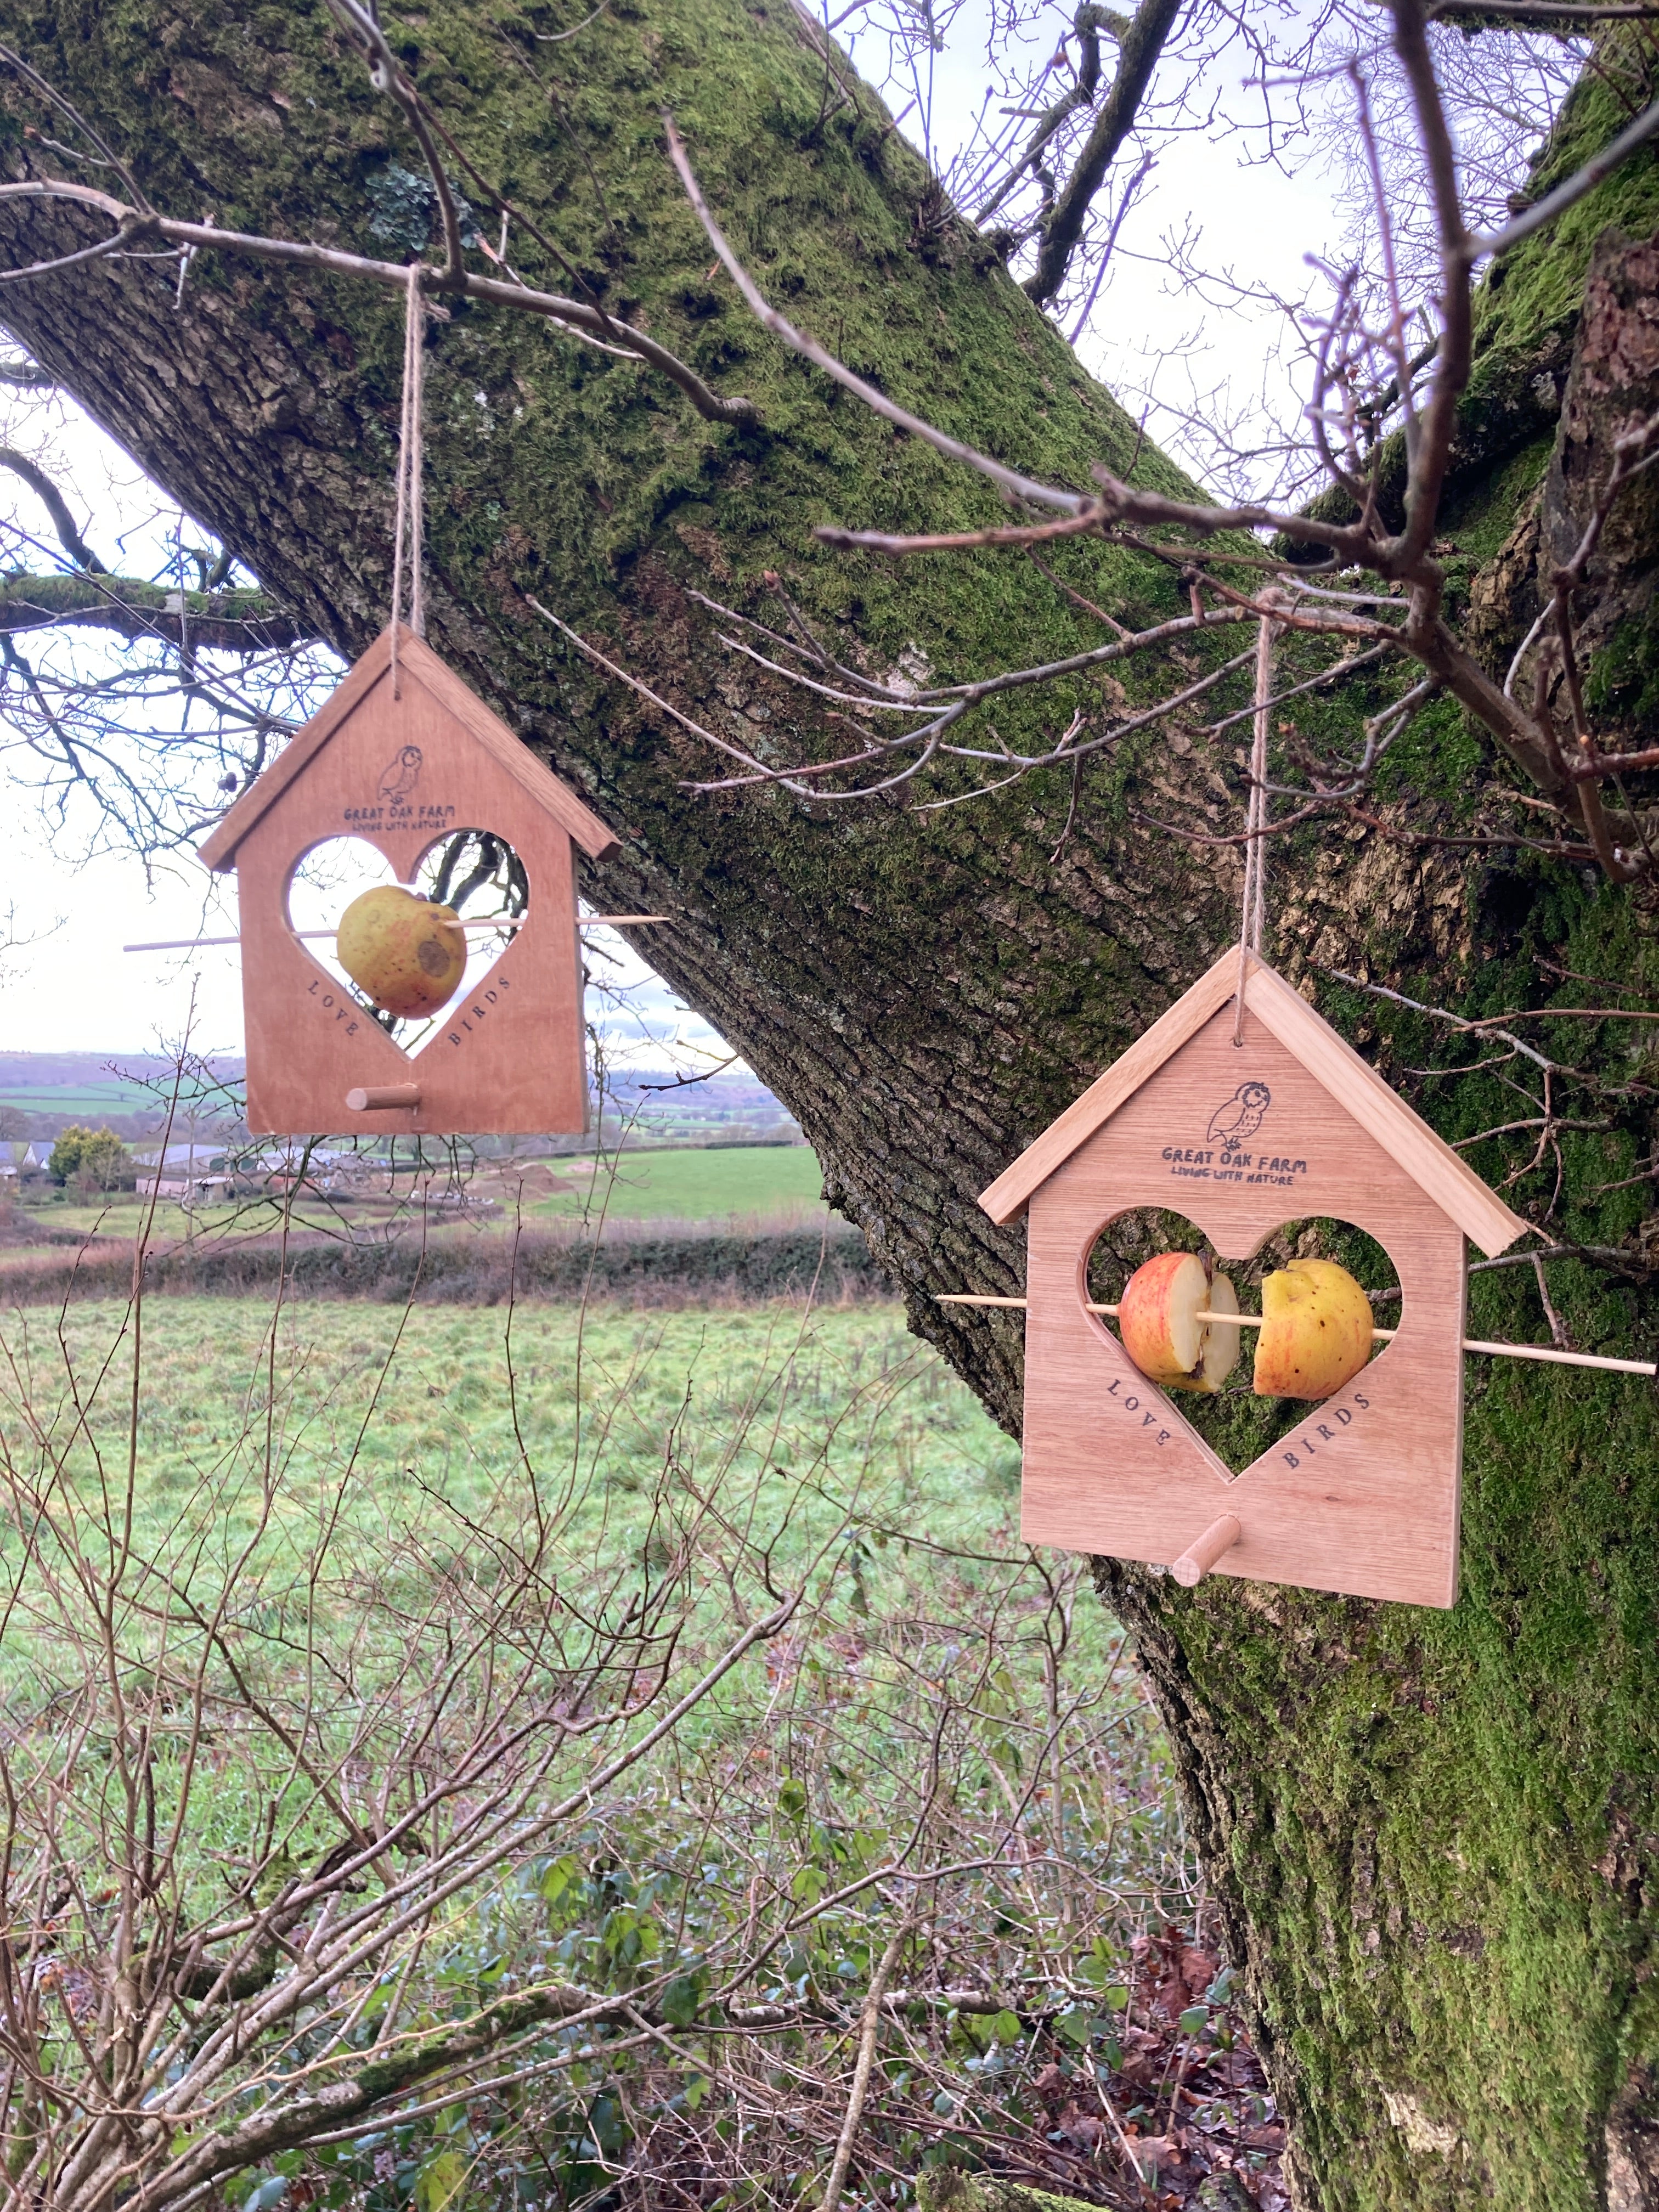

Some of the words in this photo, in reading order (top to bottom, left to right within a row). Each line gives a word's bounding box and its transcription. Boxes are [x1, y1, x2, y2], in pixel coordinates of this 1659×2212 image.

[344, 808, 384, 821] GREAT
[390, 806, 413, 819] OAK
[419, 805, 455, 817] FARM
[386, 821, 408, 831] WITH
[411, 819, 446, 830] NATURE
[308, 980, 358, 1036] LOVE
[448, 977, 510, 1045] BIRDS
[1161, 1147, 1214, 1164] GREAT
[1220, 1152, 1252, 1167] OAK
[1258, 1156, 1307, 1173] FARM
[1171, 1166, 1210, 1178] LIVING
[1214, 1170, 1243, 1181] WITH
[1246, 1174, 1294, 1186] NATURE
[1107, 1379, 1171, 1446] LOVE
[1282, 1393, 1369, 1469] BIRDS
